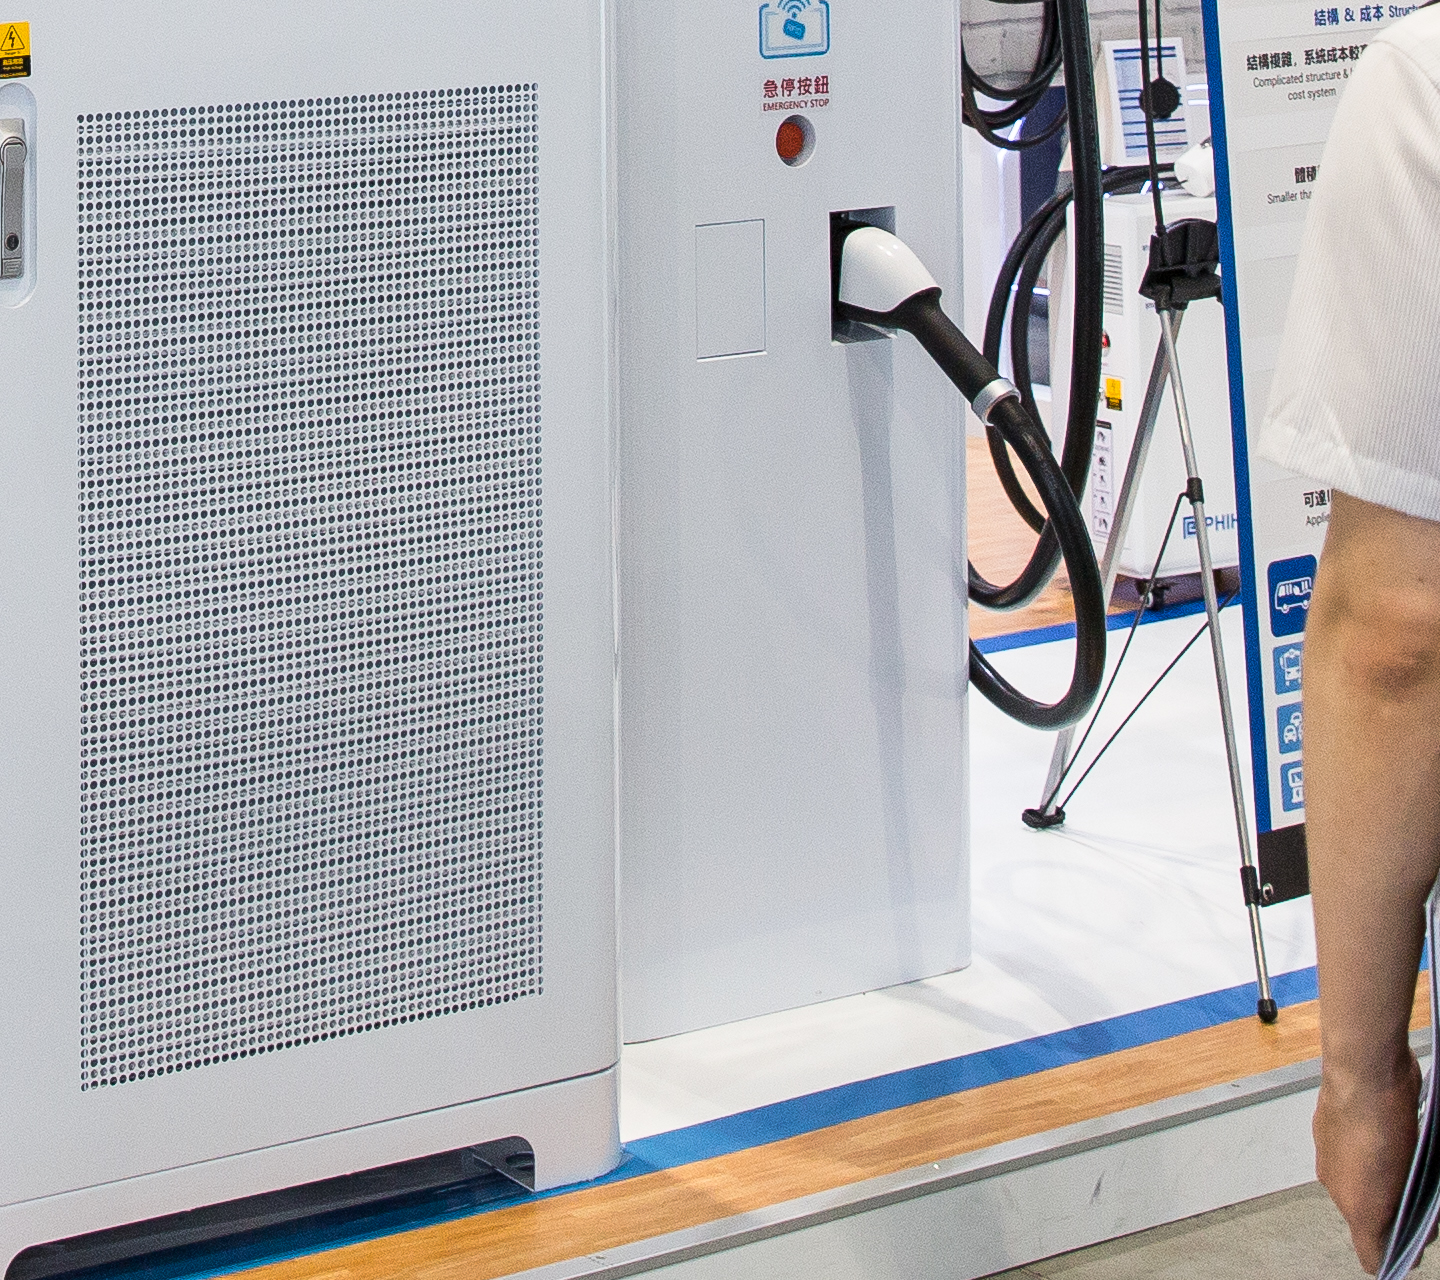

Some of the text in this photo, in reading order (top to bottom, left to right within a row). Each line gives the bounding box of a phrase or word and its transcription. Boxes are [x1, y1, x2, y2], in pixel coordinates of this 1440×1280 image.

[1344, 8, 1356, 23] &
[1359, 4, 1384, 23] 成本
[763, 75, 829, 99] 急停按鈕
[1253, 72, 1304, 89] Complicated
[1305, 70, 1341, 83] structure
[1287, 87, 1337, 101] cost system
[763, 98, 830, 112] EMERGENCY STOP
